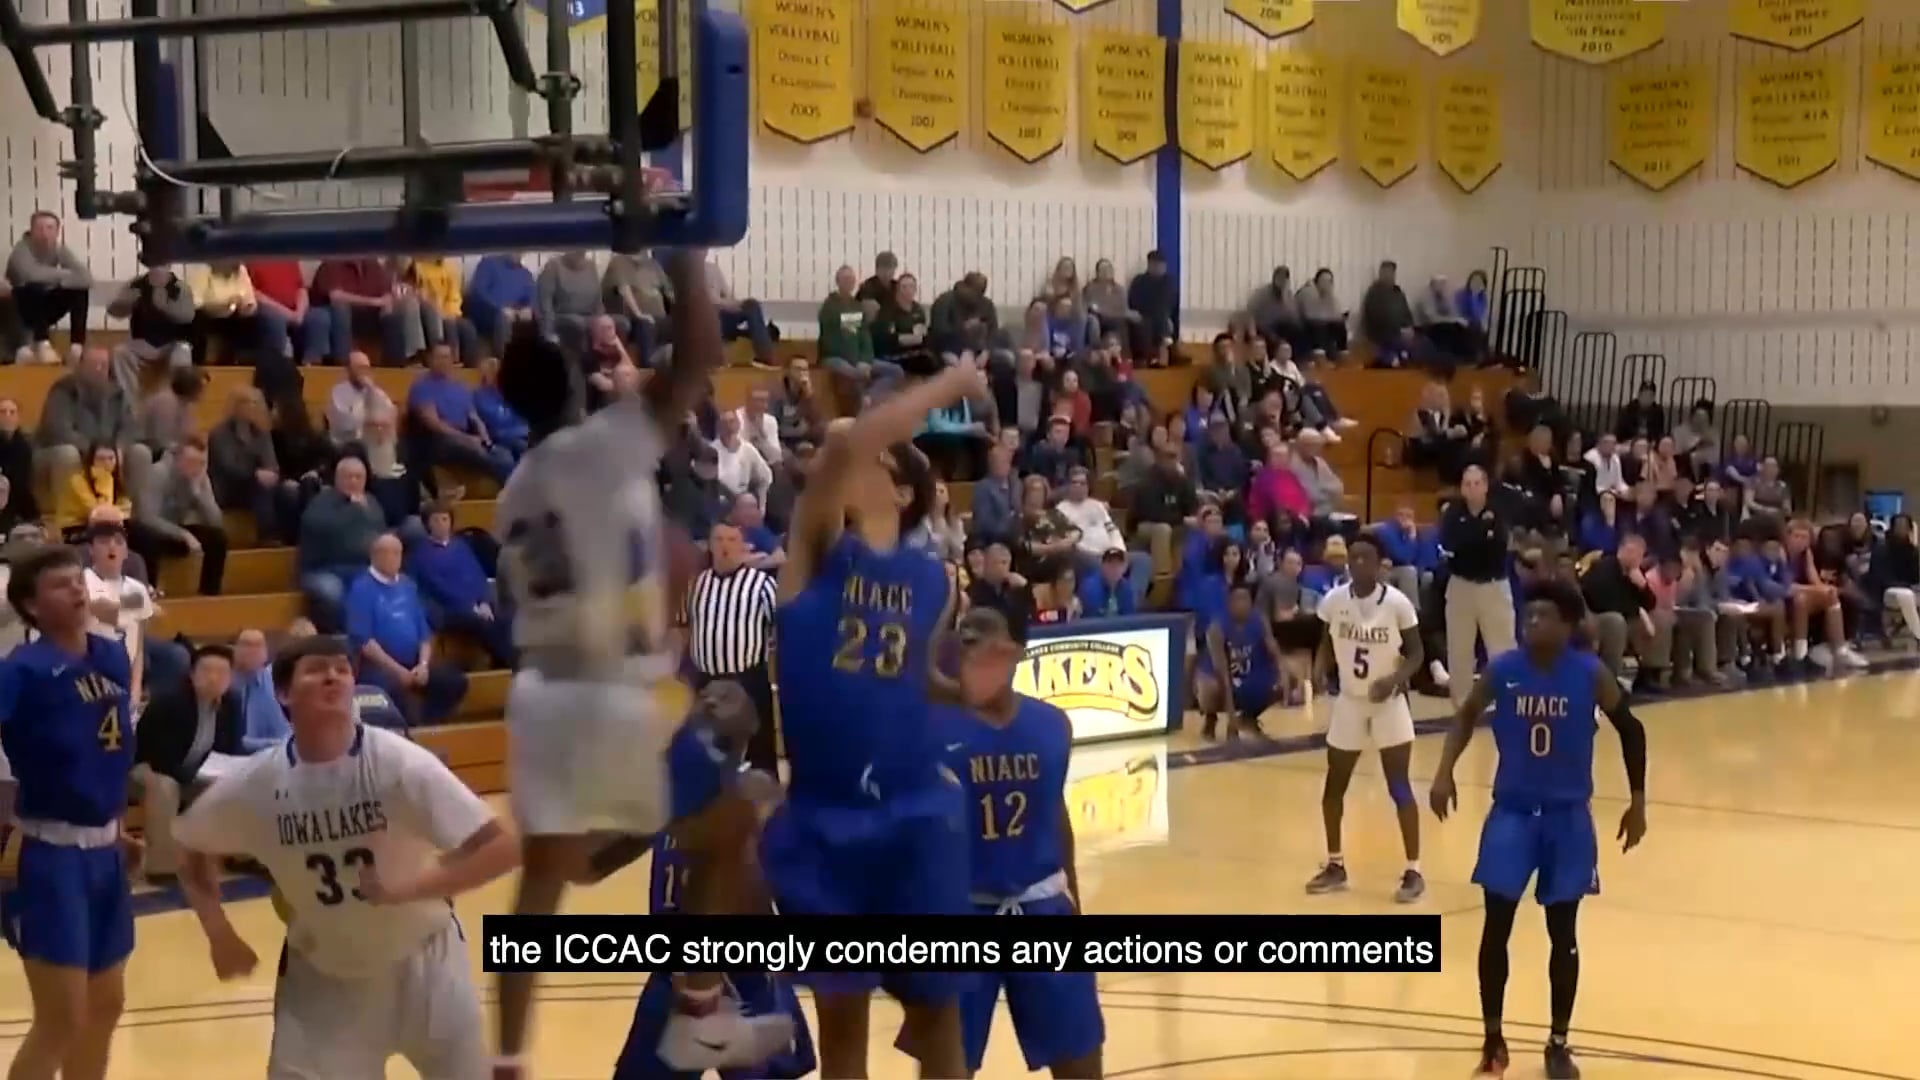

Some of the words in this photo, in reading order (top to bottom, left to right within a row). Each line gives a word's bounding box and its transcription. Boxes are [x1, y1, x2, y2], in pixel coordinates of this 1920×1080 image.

[843, 576, 912, 615] NIACC
[832, 616, 907, 678] 23
[1353, 646, 1369, 680] 5
[1012, 644, 1160, 715] AKERS
[1515, 695, 1569, 718] NIACC
[97, 706, 122, 752] 4
[1530, 722, 1551, 758] 0
[970, 752, 1040, 784] NIACC
[276, 808, 324, 847] IOWA
[324, 800, 389, 842] LAKES
[980, 790, 1028, 840] 12
